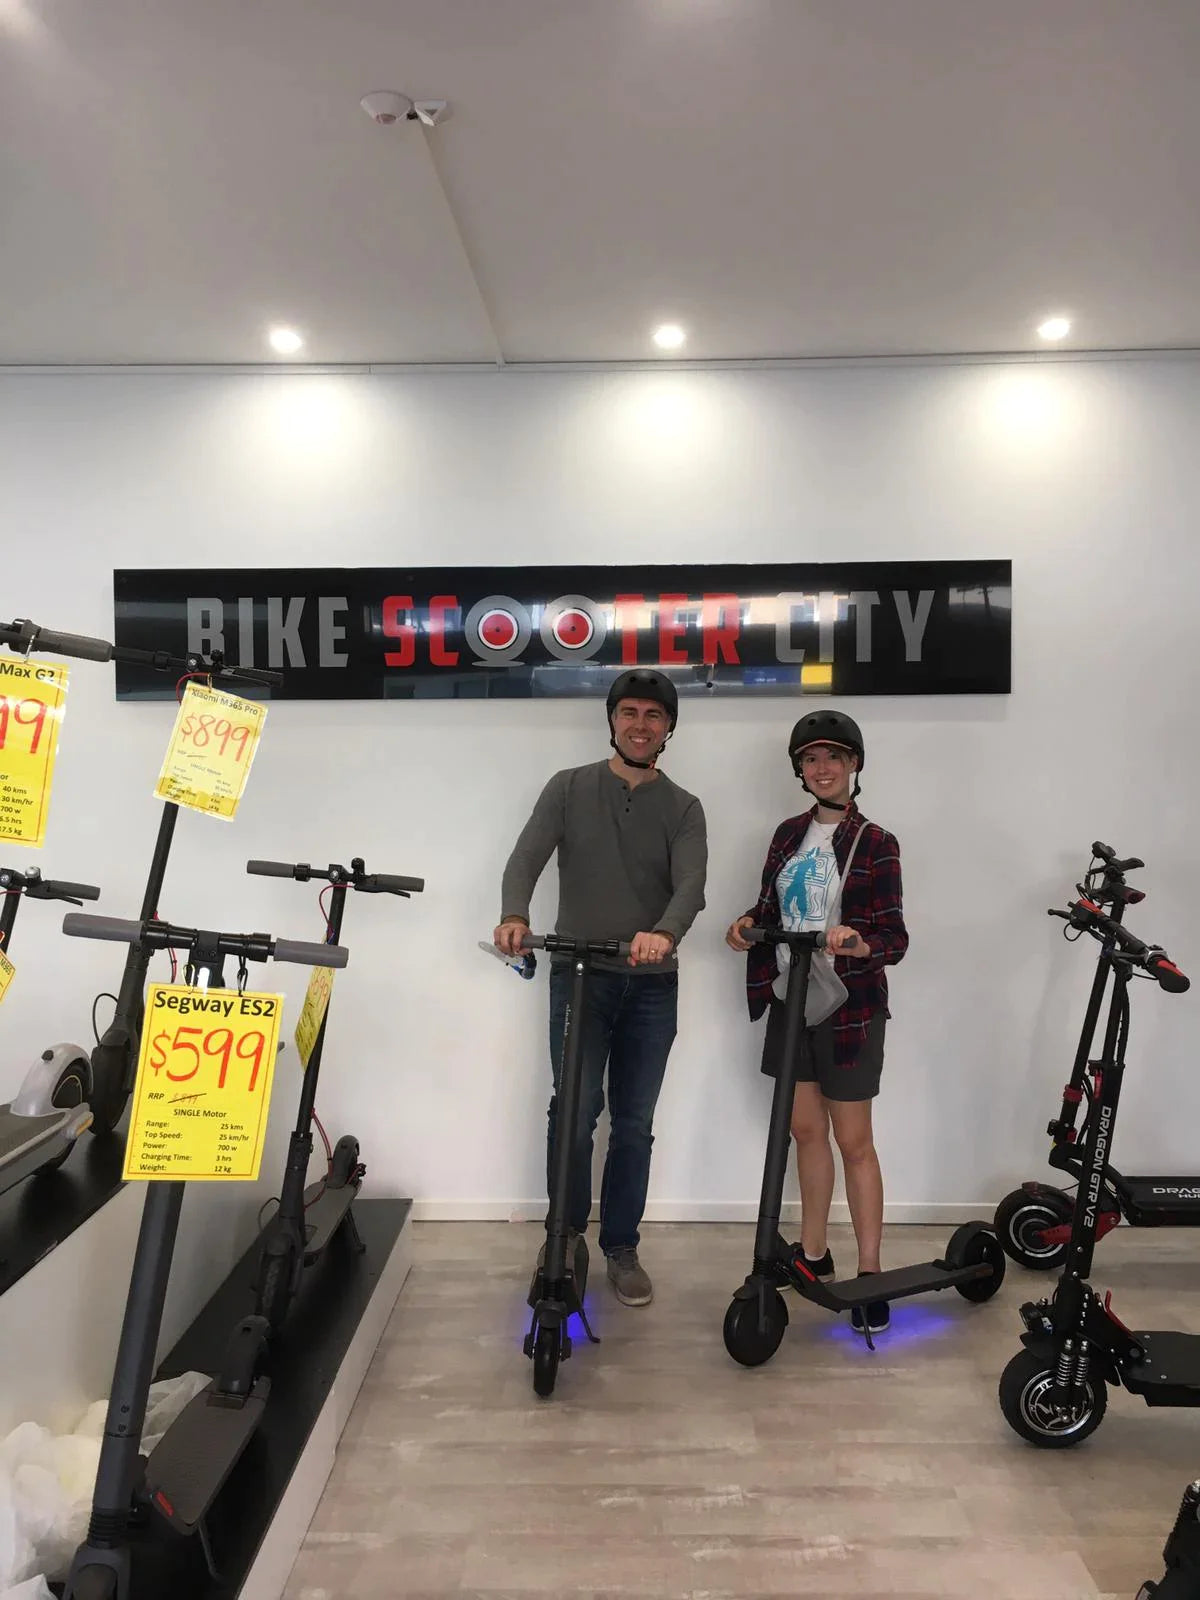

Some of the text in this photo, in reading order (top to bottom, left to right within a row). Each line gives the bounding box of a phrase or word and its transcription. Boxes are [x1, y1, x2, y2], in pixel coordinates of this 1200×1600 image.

[187, 590, 936, 668] BIKE SCOOTER CITY
[0, 663, 32, 679] Max
[191, 688, 258, 716] Xiaomi M365 Pro
[181, 711, 250, 762] $899
[13, 786, 28, 795] kms
[154, 991, 275, 1017] Segway ES2
[150, 1026, 265, 1092] $599
[147, 1092, 165, 1100] RRP
[173, 1108, 227, 1118] SINGLE Motor
[146, 1120, 170, 1129] Range:
[230, 1123, 244, 1131] kms
[144, 1131, 184, 1140] Top Speed:
[229, 1134, 250, 1142] km/hr
[141, 1152, 192, 1162] Charging Time:
[139, 1164, 167, 1172] Weight:
[223, 1165, 232, 1173] kg
[1083, 1104, 1112, 1228] DRAGON GTR V2
